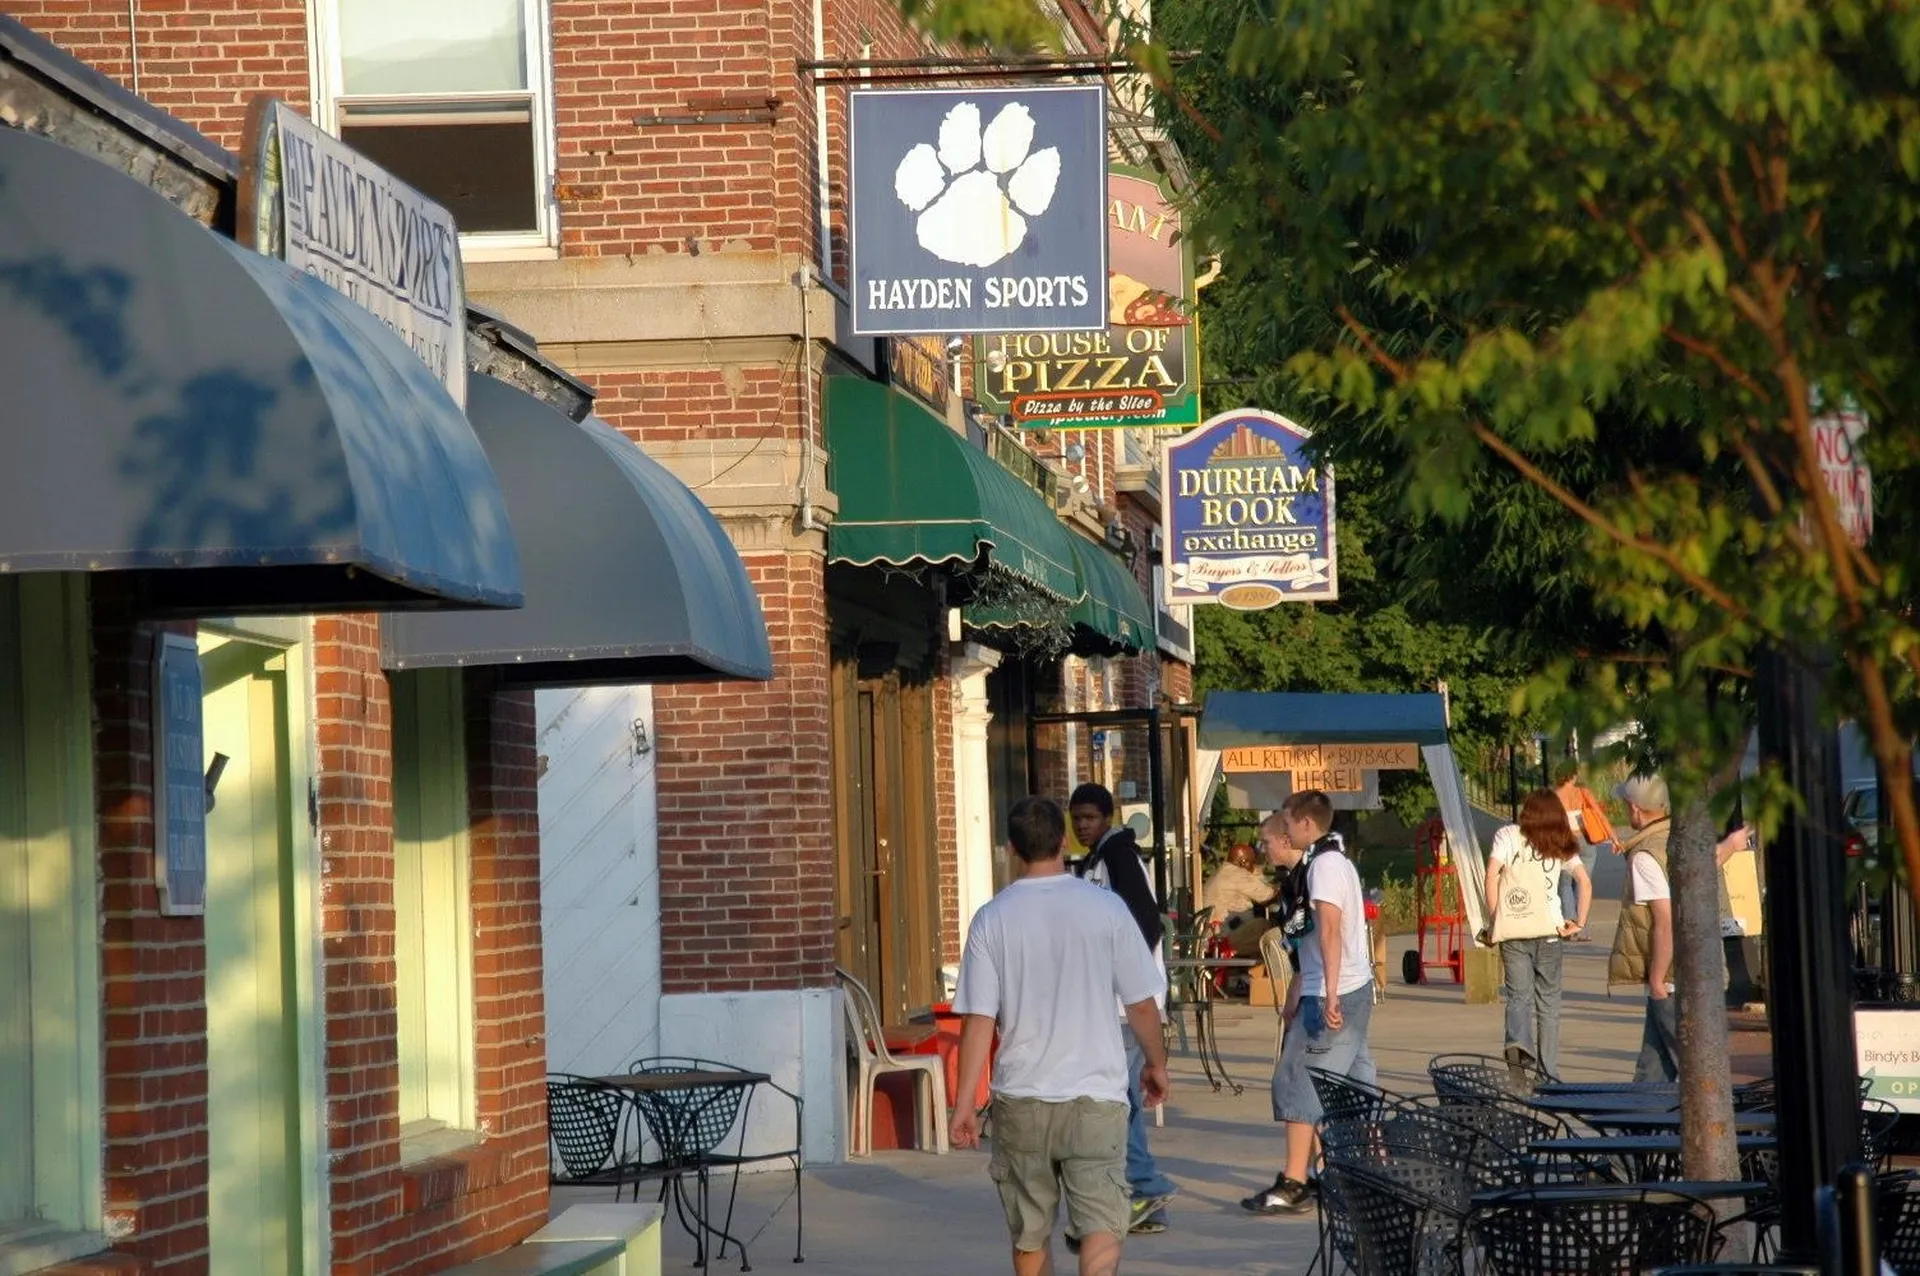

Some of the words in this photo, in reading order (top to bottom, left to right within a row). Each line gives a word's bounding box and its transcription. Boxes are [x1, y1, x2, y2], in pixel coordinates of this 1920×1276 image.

[868, 278, 972, 310] HAYDEN
[984, 275, 1089, 309] SPORTS
[998, 331, 1110, 358] HOUSE
[1126, 327, 1171, 353] OF
[1000, 355, 1177, 393] PIZZA
[1024, 400, 1062, 415] Pizza
[1068, 398, 1084, 414] by
[1090, 397, 1114, 412] the
[1119, 394, 1152, 410] Slice
[1816, 426, 1852, 466] NO
[1179, 466, 1320, 497] DURHAM
[1201, 496, 1297, 527] BOOK
[1184, 528, 1317, 553] exchange
[1226, 751, 1258, 767] ALL
[1339, 748, 1406, 765] BUYBACK
[1864, 1050, 1908, 1065] Bindy's
